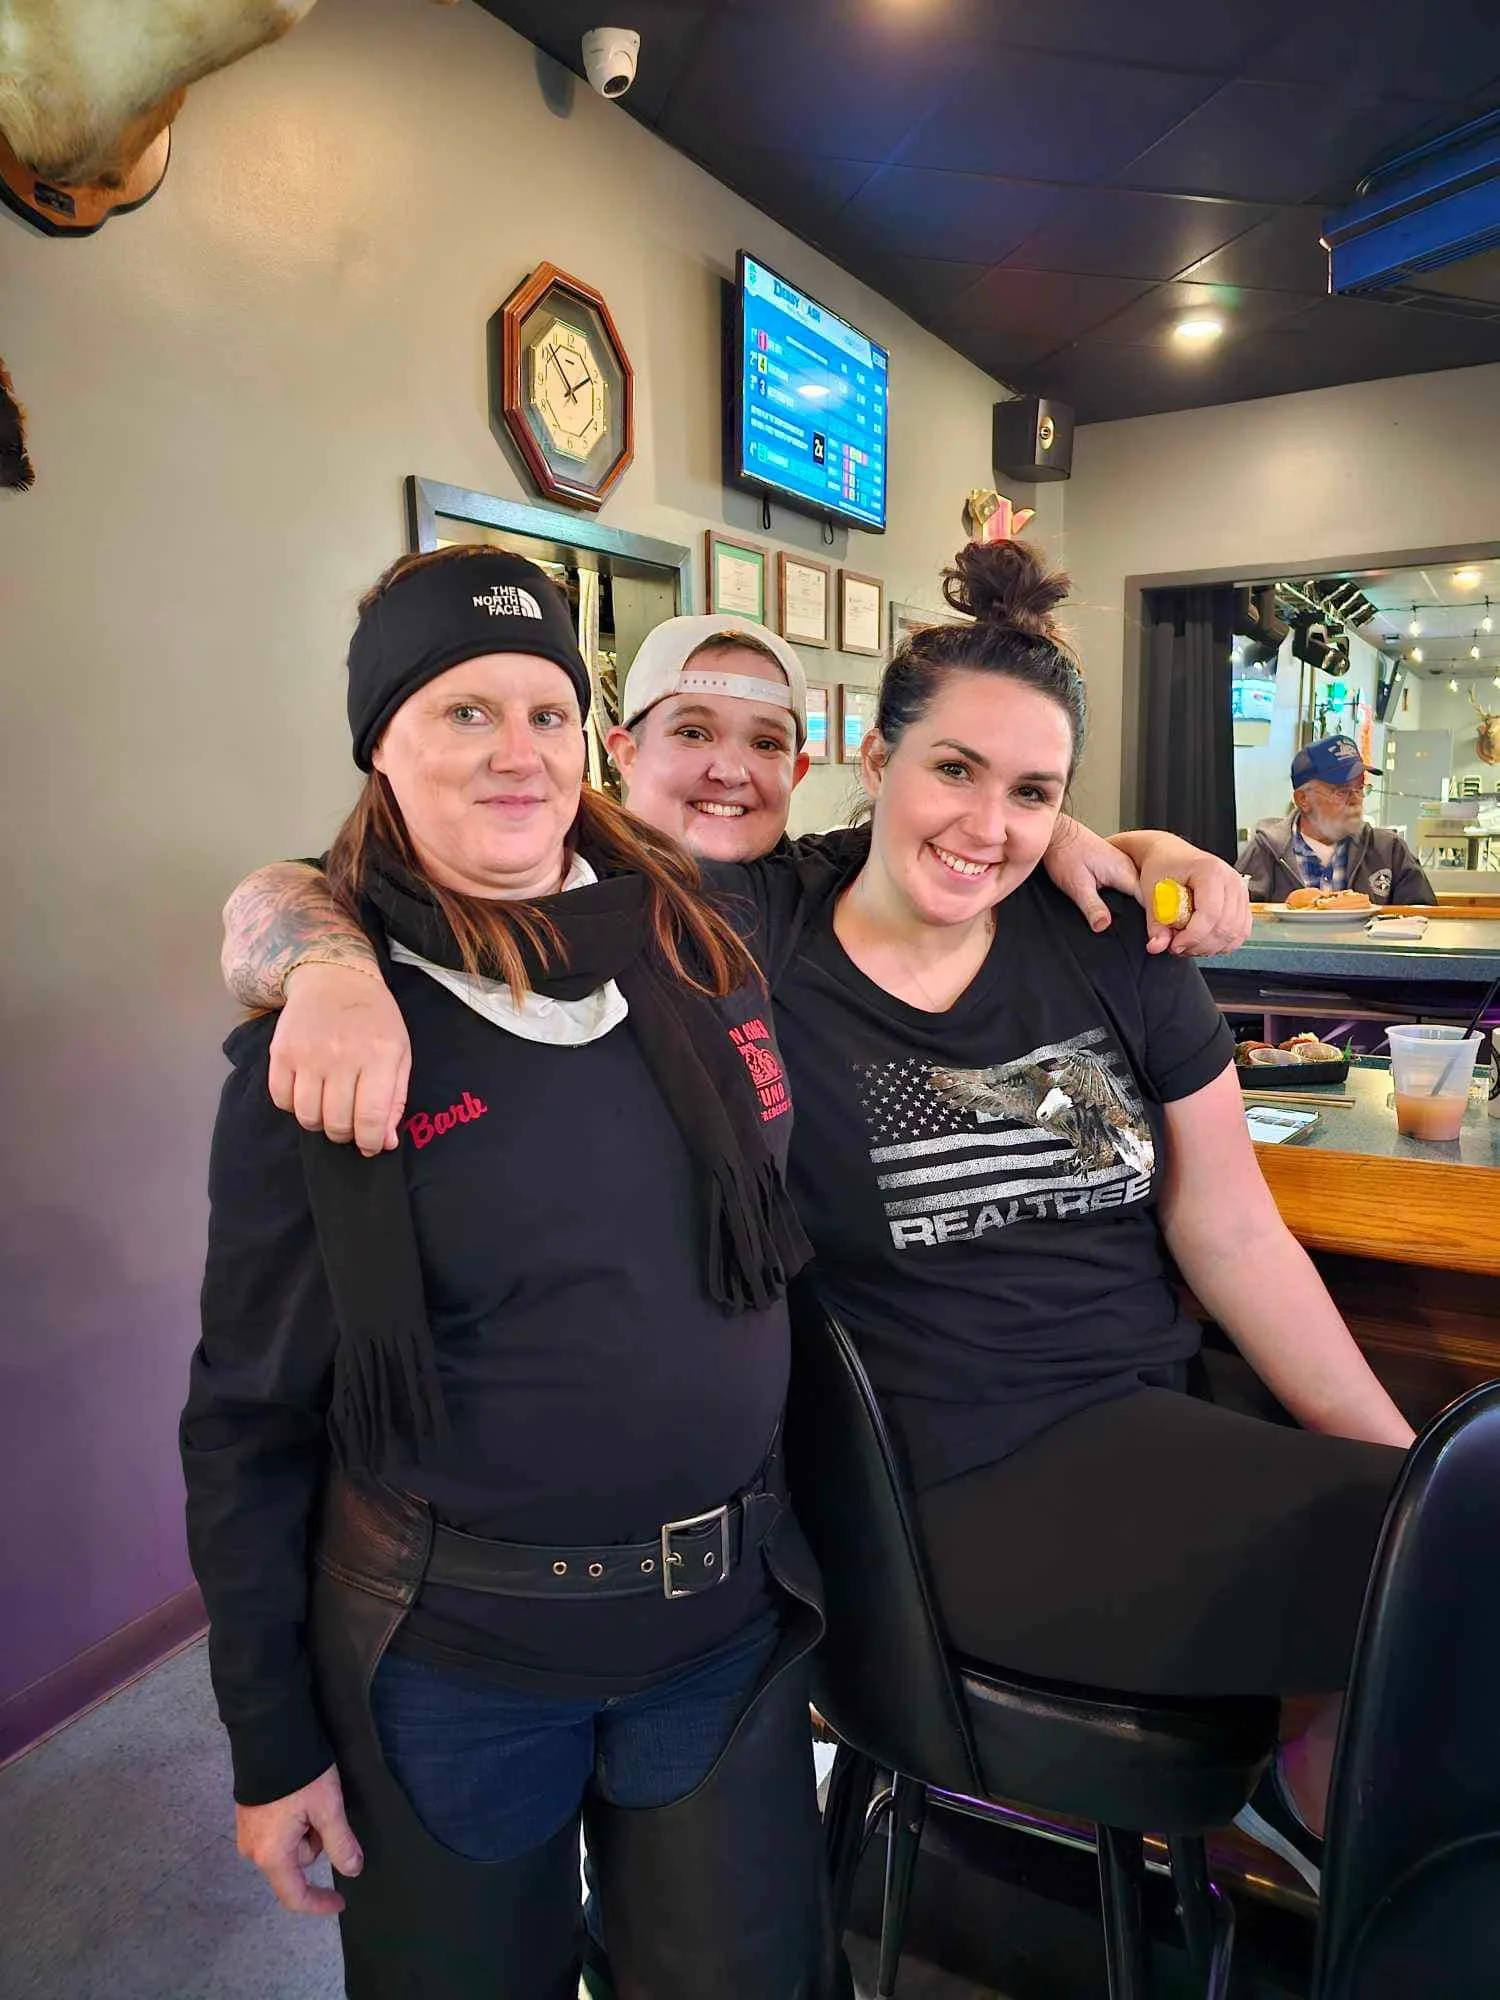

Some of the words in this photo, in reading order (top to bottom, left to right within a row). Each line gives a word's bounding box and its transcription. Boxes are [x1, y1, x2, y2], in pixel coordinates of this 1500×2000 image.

[490, 585, 516, 596] THE
[472, 594, 519, 607] NORTH
[488, 604, 521, 616] FACE
[406, 1091, 488, 1149] Barb
[888, 1175, 1153, 1250] REALTREE
